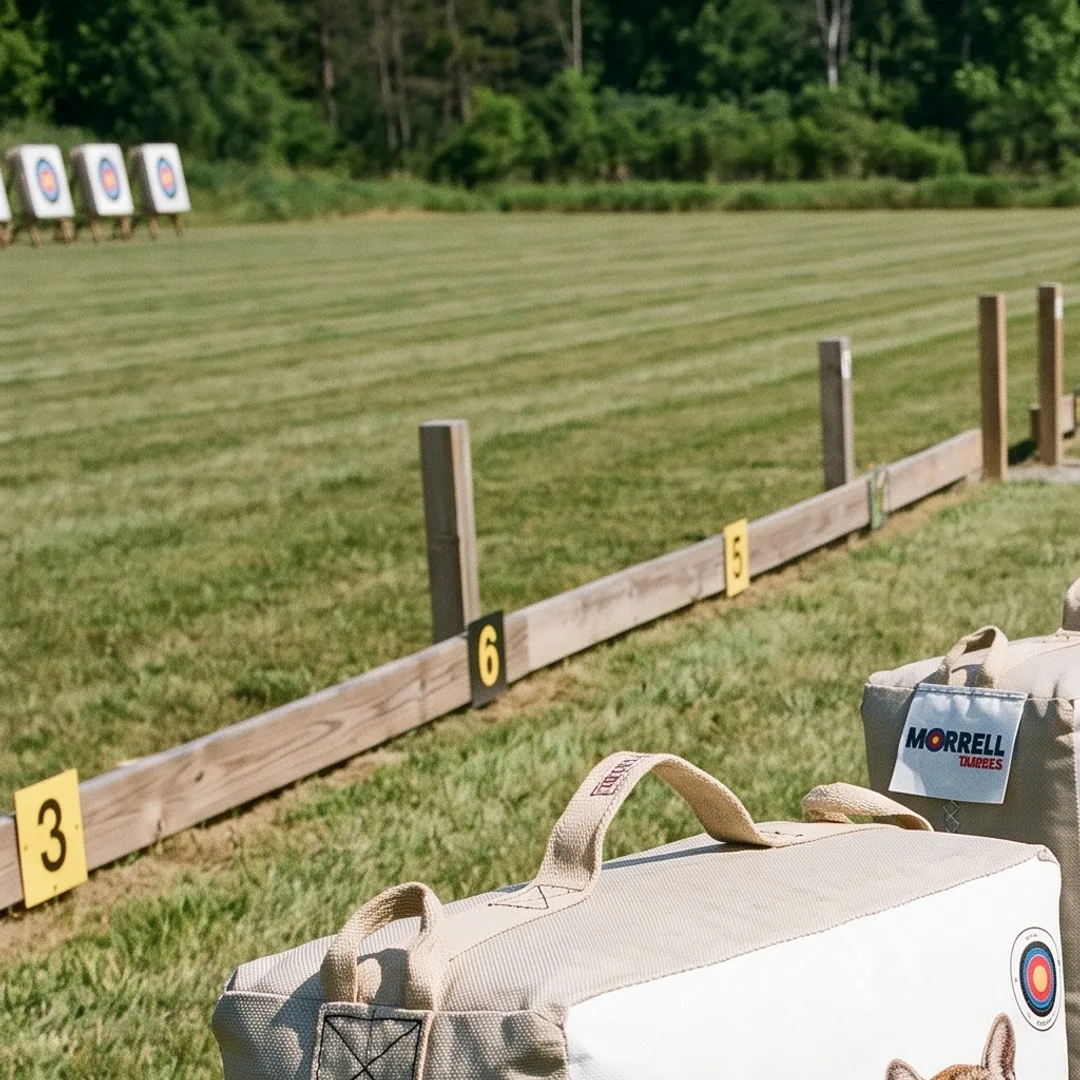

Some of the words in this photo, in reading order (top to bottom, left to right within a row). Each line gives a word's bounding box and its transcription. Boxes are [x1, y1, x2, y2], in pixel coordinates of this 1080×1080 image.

[732, 536, 744, 578] 5
[478, 624, 500, 688] 6
[905, 727, 1005, 757] MORRELL
[38, 798, 66, 872] 3
